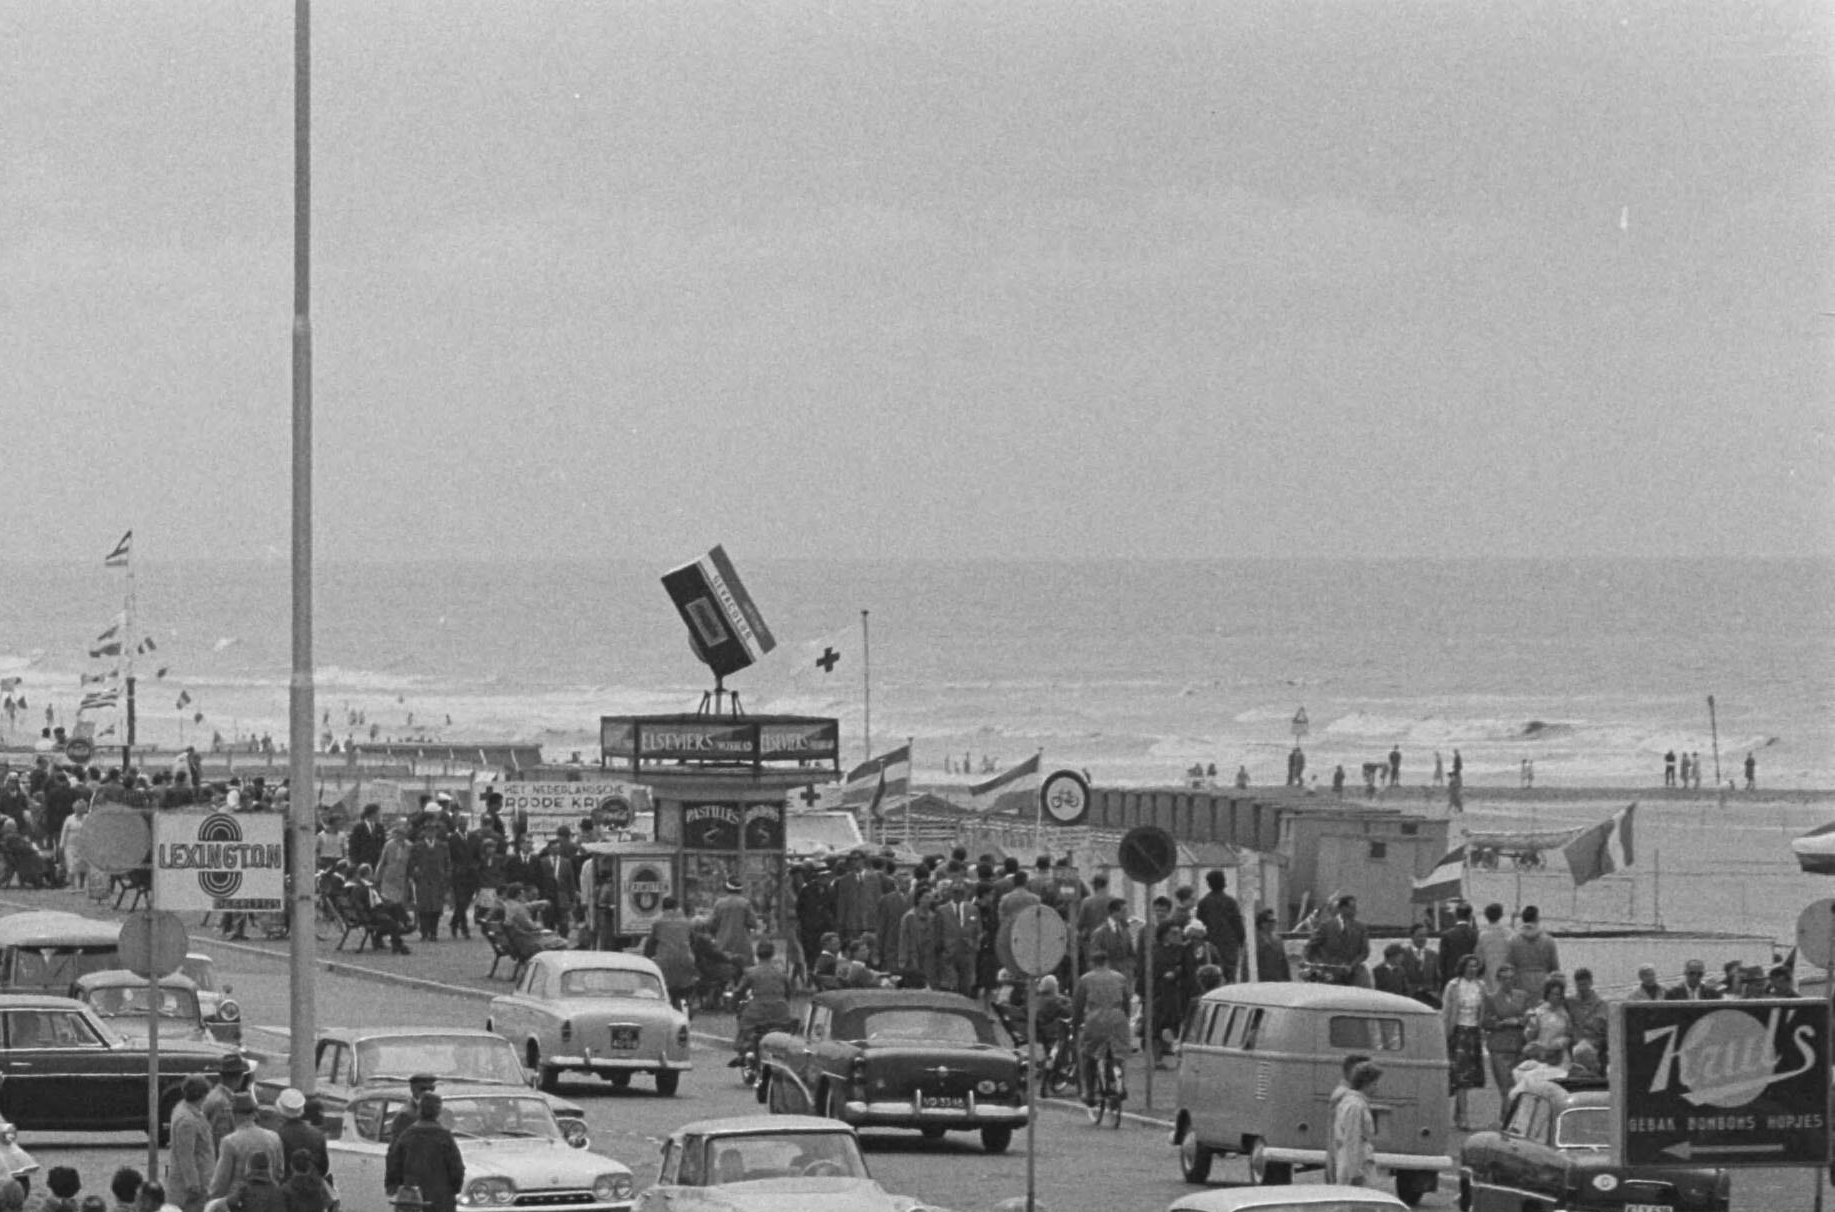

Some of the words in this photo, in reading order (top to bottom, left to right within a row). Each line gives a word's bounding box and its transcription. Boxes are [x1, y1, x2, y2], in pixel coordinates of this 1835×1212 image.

[641, 732, 713, 752] ELSEVIERS
[760, 733, 808, 753] ELSEVIERS
[505, 783, 526, 795] HET
[532, 783, 625, 796] NEDERLANDSCHE
[505, 796, 564, 809] ROODE
[685, 805, 740, 824] PASTILLES
[158, 843, 282, 869] LEXINGTON
[1628, 1116, 1676, 1132] GEBAK
[1687, 1115, 1757, 1131] BONBONS
[1765, 1113, 1824, 1129] HOPJES
